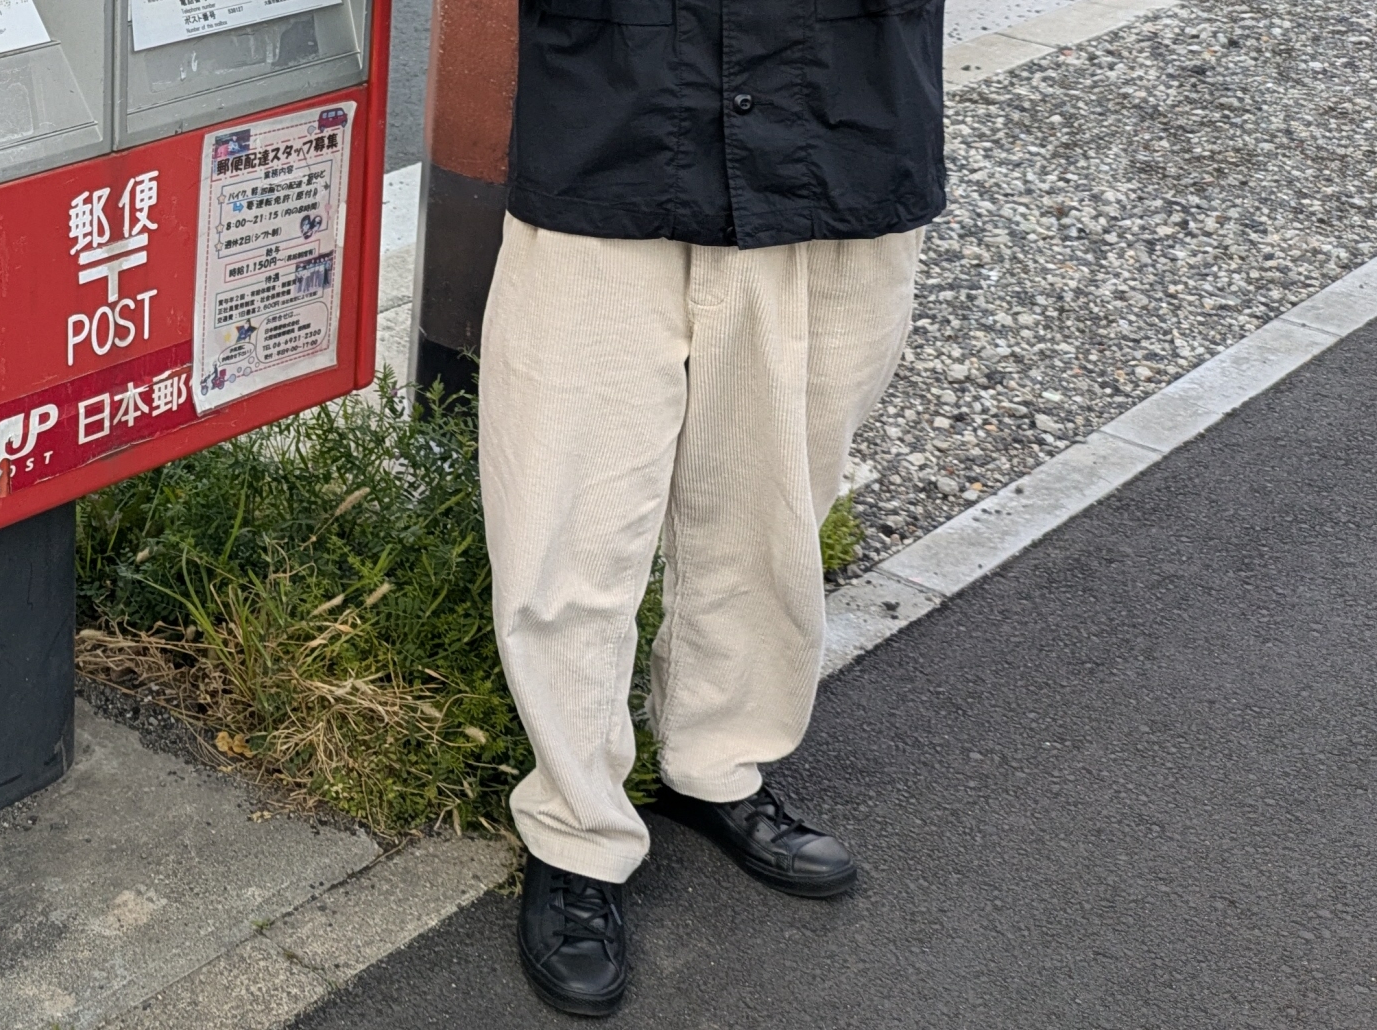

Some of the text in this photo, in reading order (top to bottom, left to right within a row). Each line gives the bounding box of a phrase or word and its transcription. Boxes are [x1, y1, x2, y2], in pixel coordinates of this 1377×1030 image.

[184, 10, 216, 25] ポスト番号
[216, 132, 339, 176] 郵便配達スタッフ募集
[69, 170, 159, 256] 郵便
[265, 245, 281, 258] 給与
[264, 272, 280, 286] 待遇
[67, 289, 158, 366] POST
[262, 343, 272, 352] TEL
[78, 371, 193, 445] 日本郵
